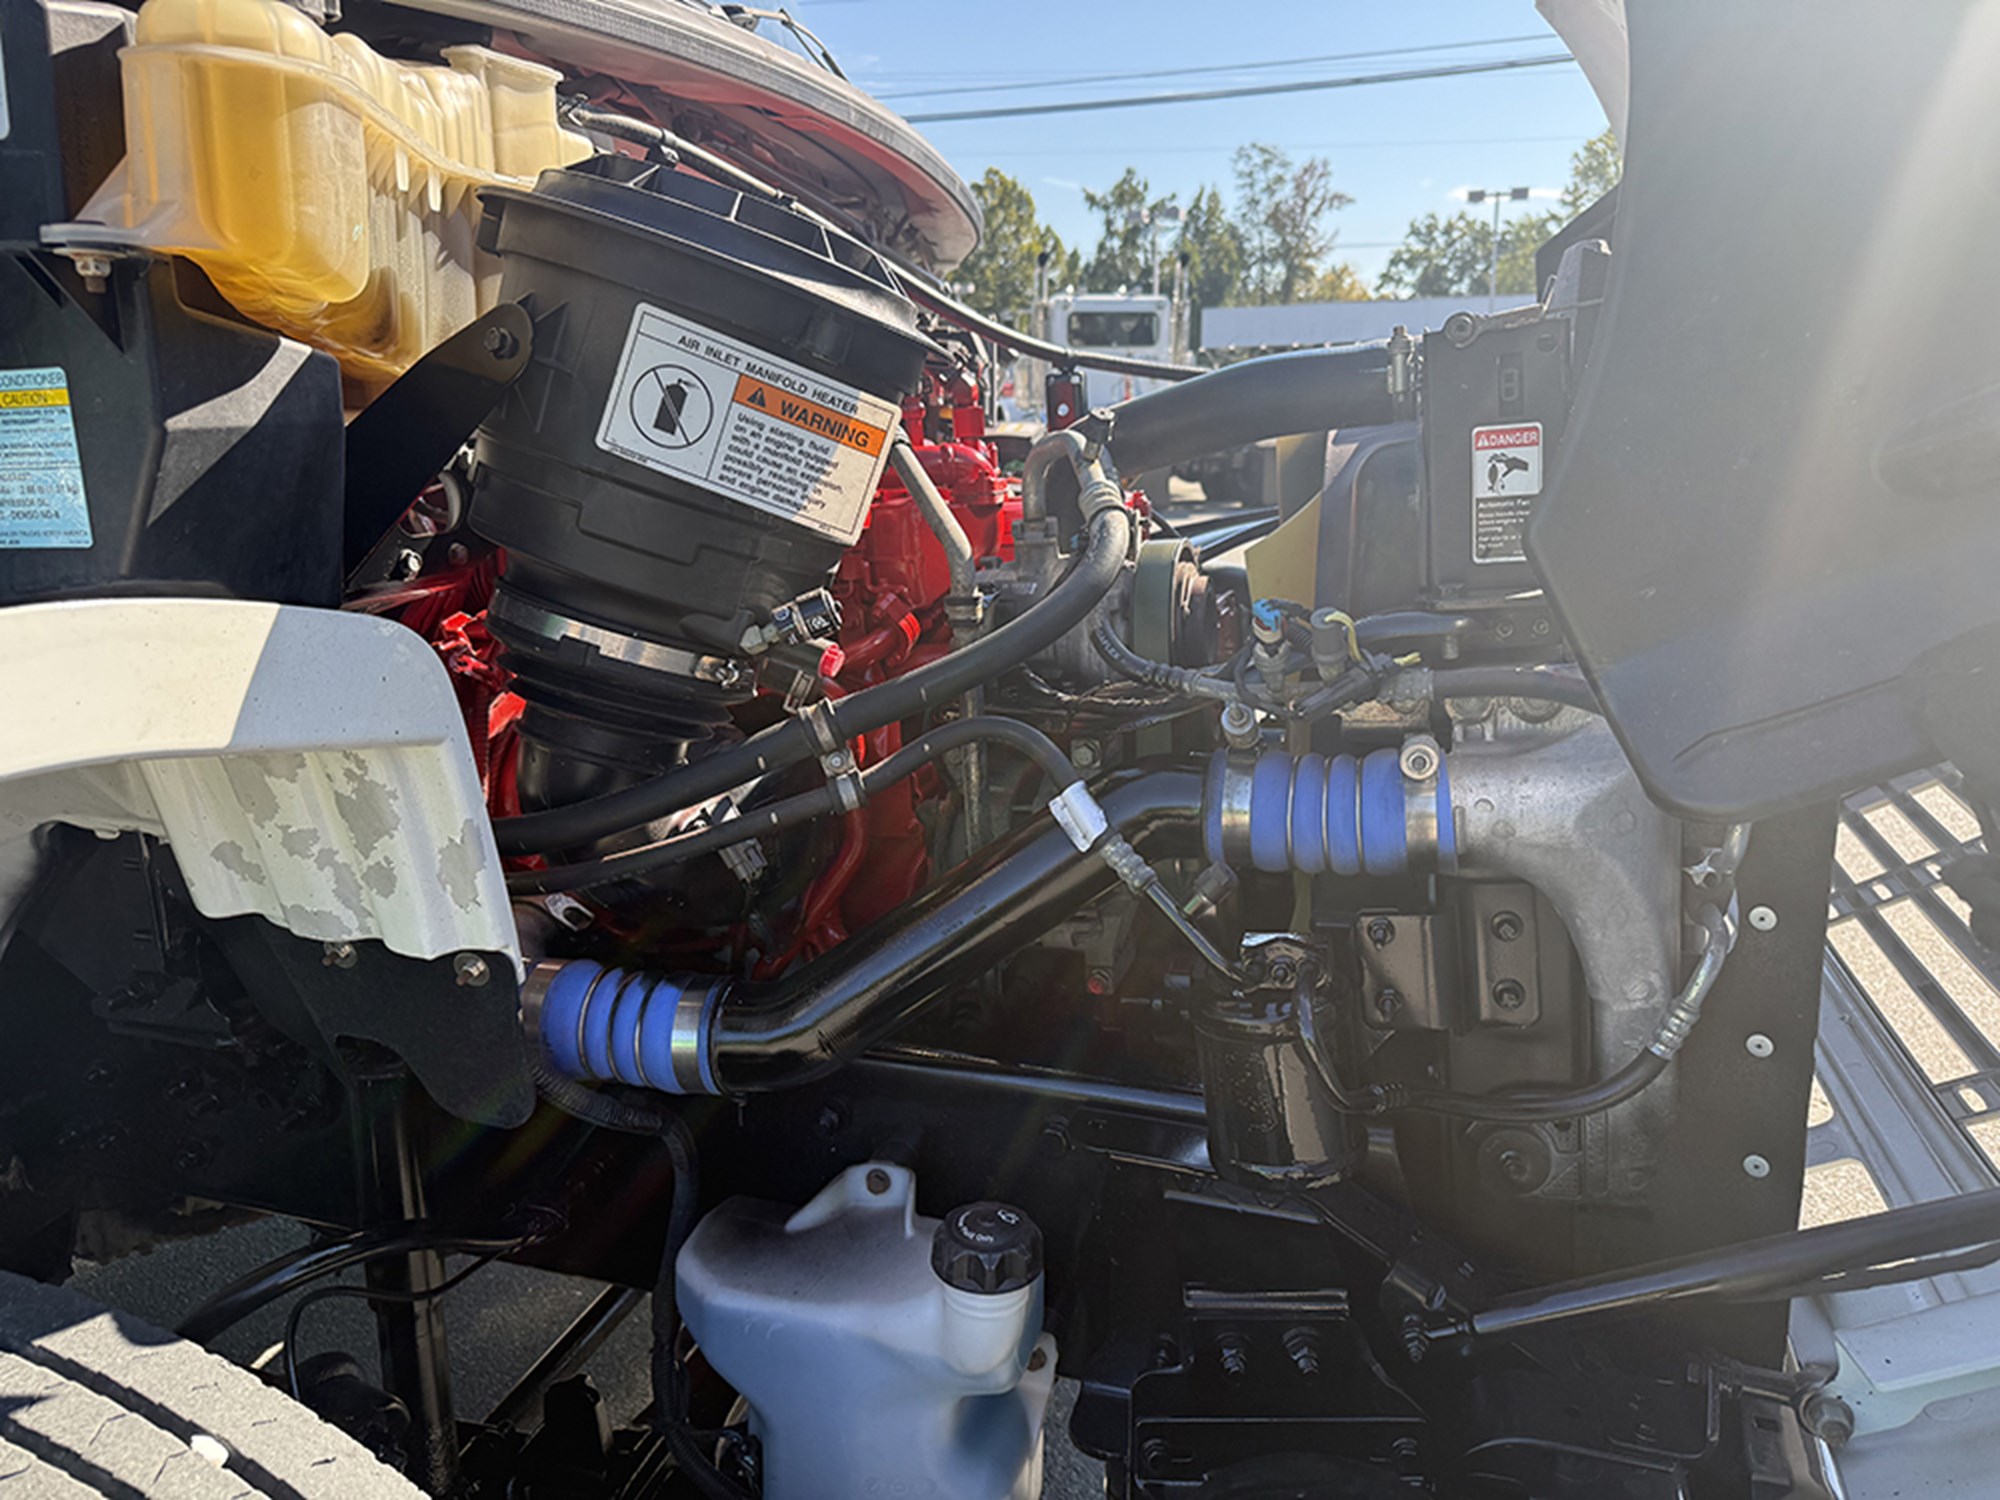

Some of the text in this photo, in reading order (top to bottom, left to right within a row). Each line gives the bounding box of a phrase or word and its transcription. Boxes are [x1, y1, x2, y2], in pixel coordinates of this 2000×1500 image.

[677, 334, 858, 415] AIR INLET MANIFOLD HEATER
[736, 412, 830, 454] Using starting fluid
[780, 400, 870, 448] WARNING
[1489, 431, 1538, 446] DANGER
[727, 443, 754, 458] could
[756, 454, 782, 469] cause
[730, 433, 751, 446] with
[762, 445, 802, 466] manifold
[804, 460, 832, 476] heater
[763, 435, 795, 453] engine
[797, 448, 838, 470] equipped
[718, 472, 736, 485] and
[738, 480, 770, 499] engine
[721, 463, 752, 480] severe
[756, 476, 797, 497] personal
[724, 452, 764, 474] possibly
[767, 469, 809, 492] resulting
